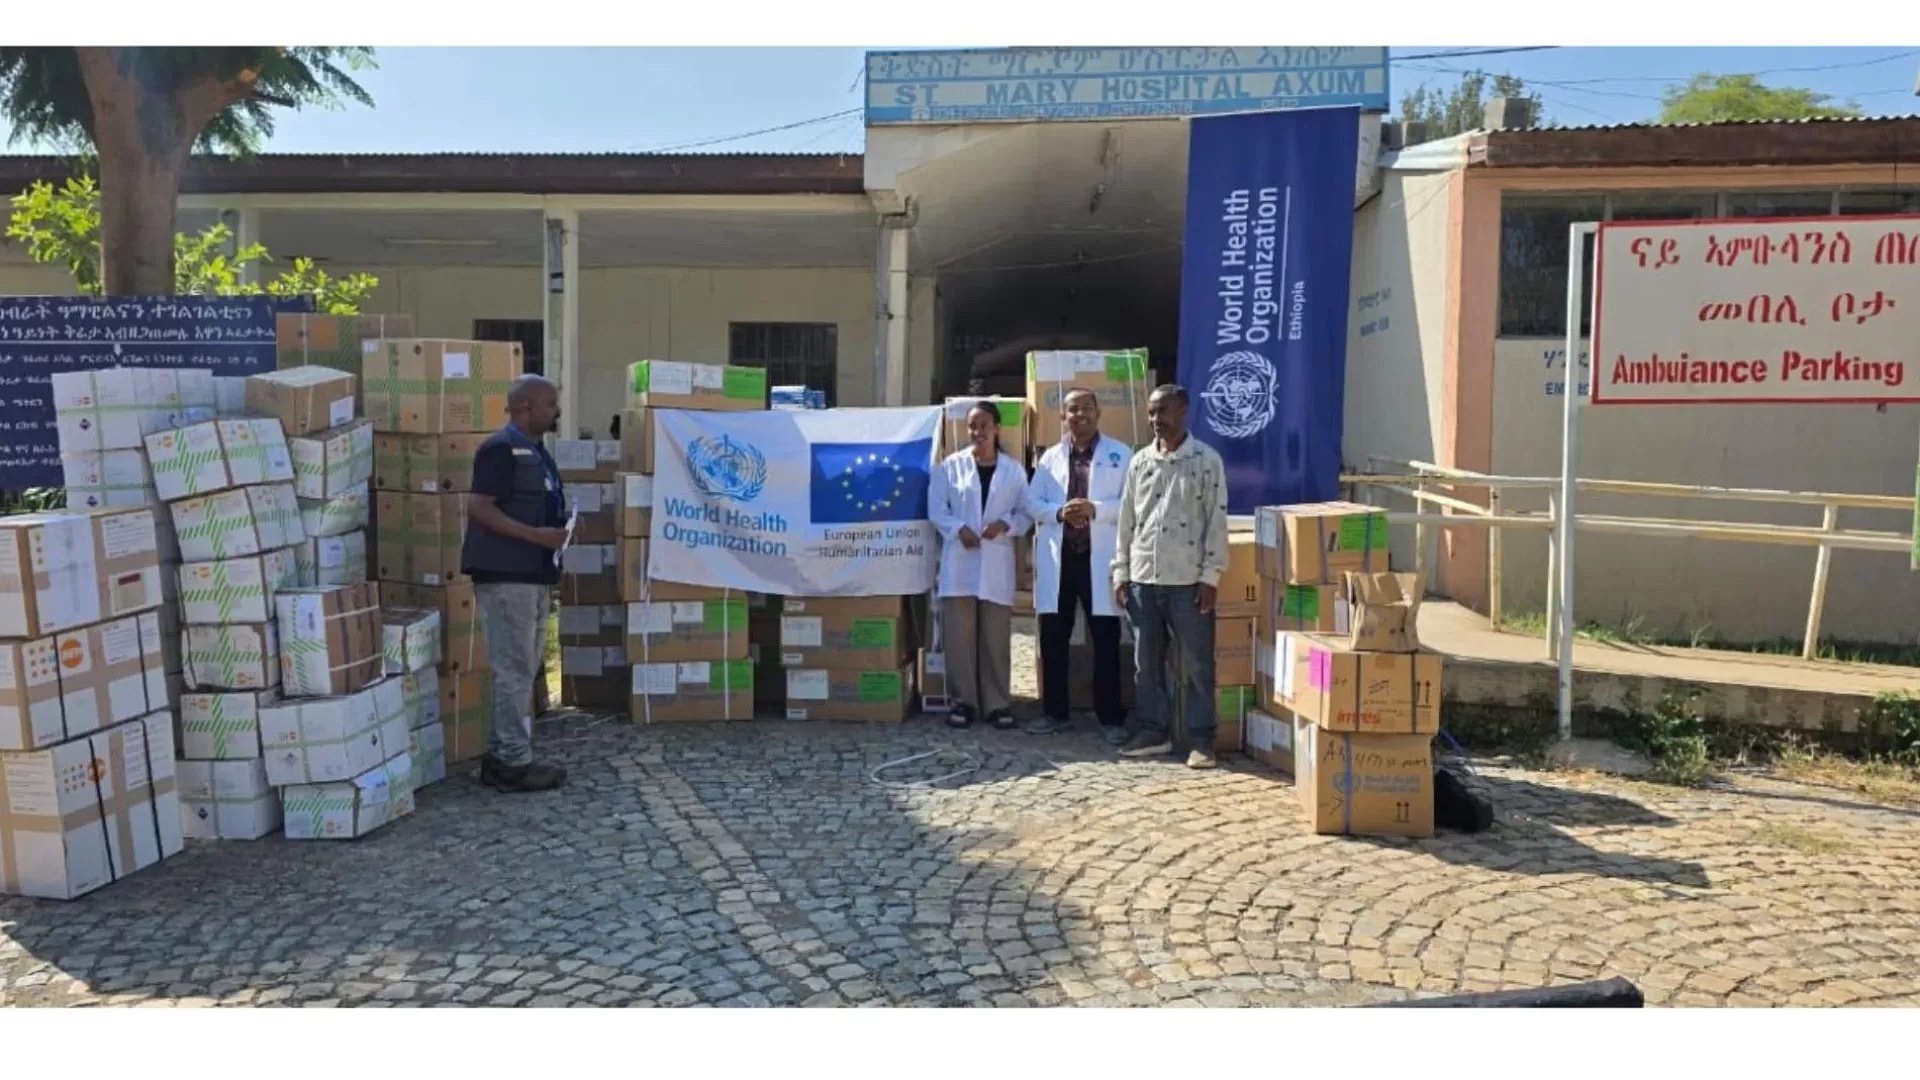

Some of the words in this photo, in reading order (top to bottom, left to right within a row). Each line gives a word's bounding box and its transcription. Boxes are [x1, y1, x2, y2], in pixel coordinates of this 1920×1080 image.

[894, 83, 939, 105] ST
[985, 79, 1077, 104] MARY
[1102, 76, 1250, 100] HOSPITAL
[1272, 70, 1366, 95] AXUM
[1221, 188, 1251, 267] Health
[1245, 186, 1279, 345] Organization
[1630, 236, 1681, 269] ናይ
[1216, 275, 1245, 345] World
[1288, 280, 1306, 341] Ethiopia
[1698, 294, 1807, 326] መበሊ
[1831, 290, 1896, 325] ቦታ
[1781, 350, 1905, 387] Parking
[663, 496, 721, 525] World
[725, 507, 788, 534] Health
[662, 522, 787, 557] Organization
[819, 545, 902, 559] Humanitarian
[907, 544, 924, 557] Aid
[824, 527, 882, 541] European
[886, 527, 921, 539] Union
